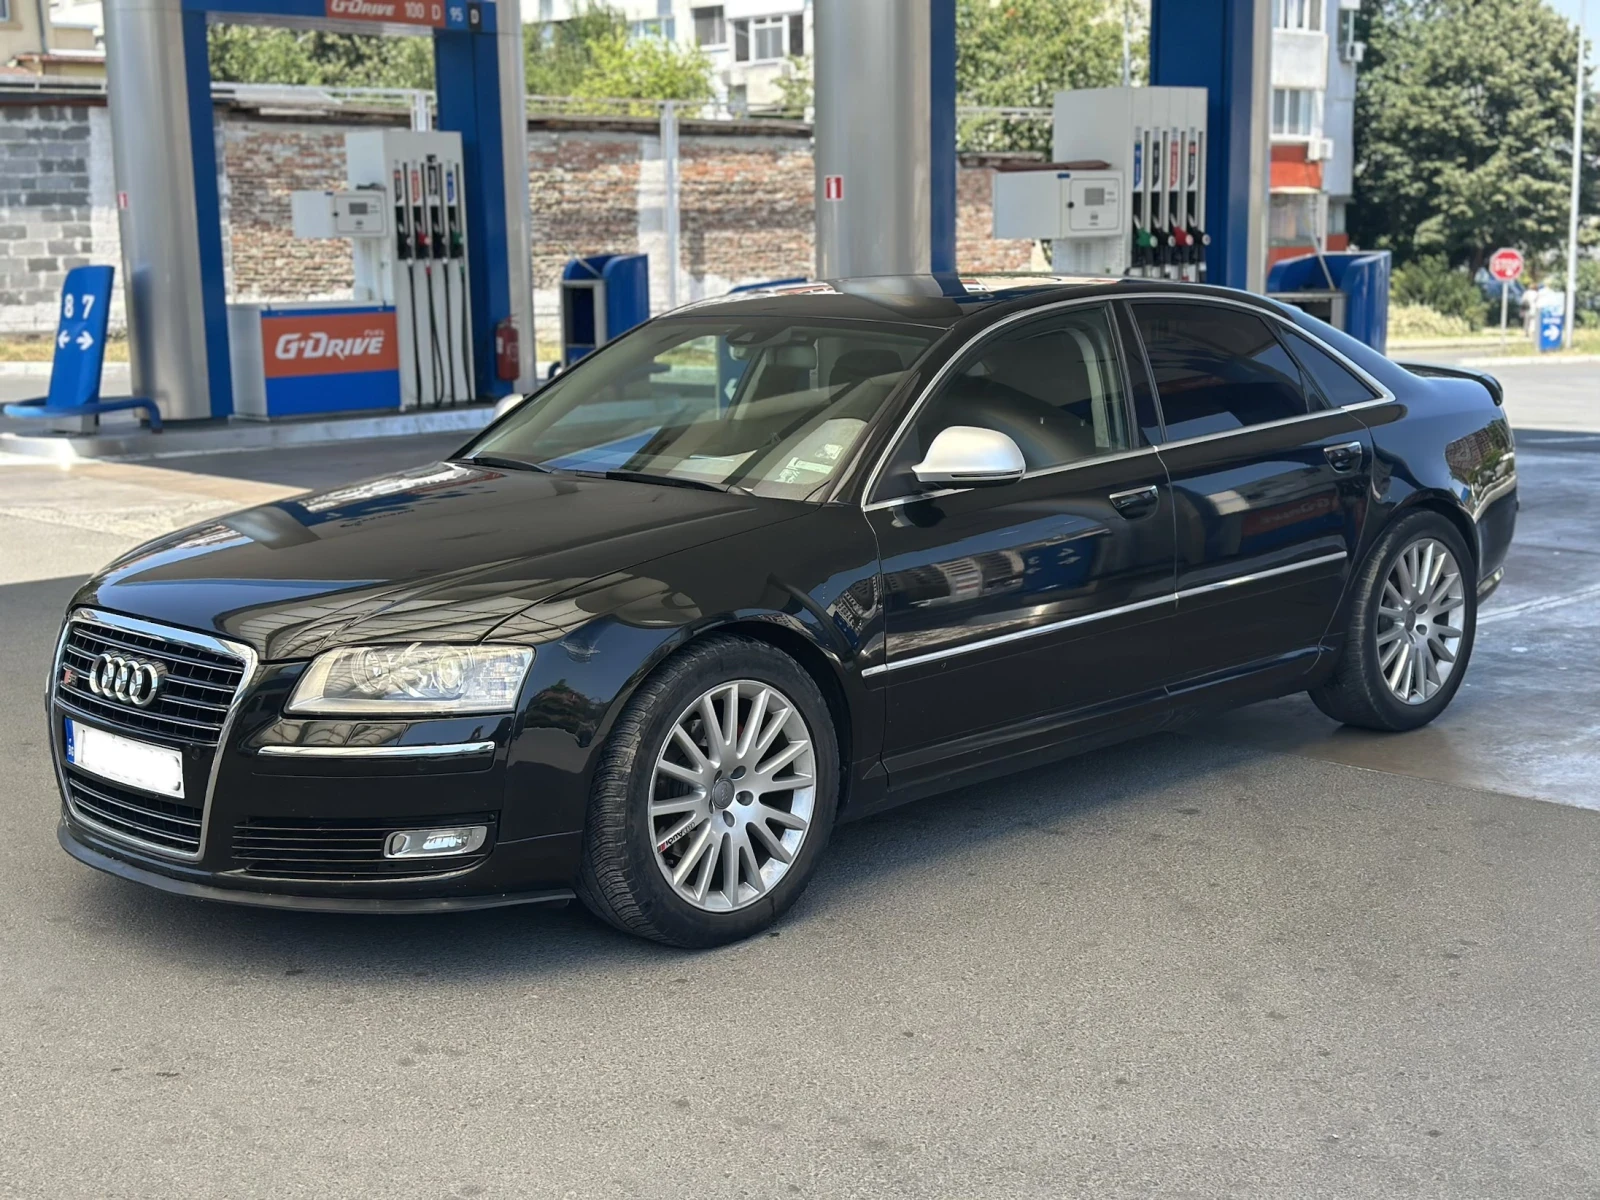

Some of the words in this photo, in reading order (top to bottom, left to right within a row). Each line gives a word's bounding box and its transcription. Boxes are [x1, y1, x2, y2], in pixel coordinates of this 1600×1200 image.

[405, 3, 425, 19] 100
[432, 4, 441, 20] D
[450, 7, 463, 22] 95
[64, 293, 74, 319] 8
[82, 294, 96, 319] 7
